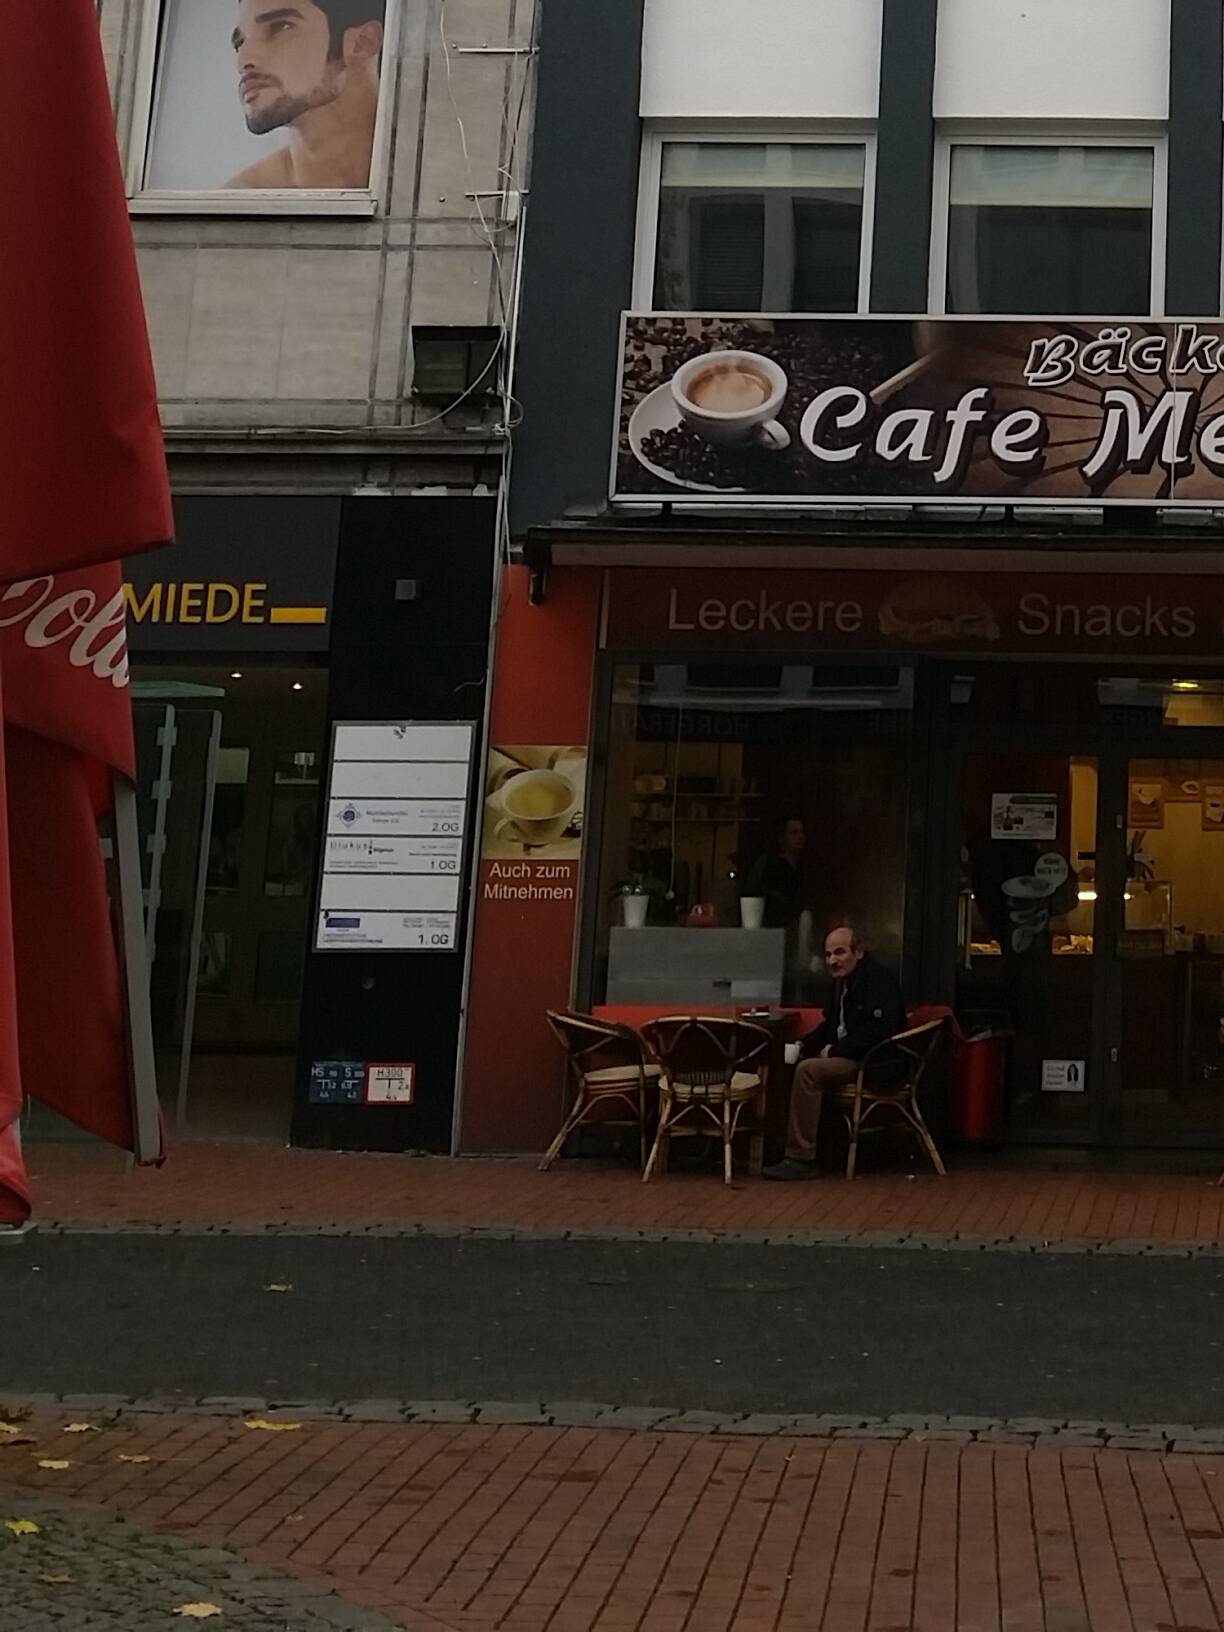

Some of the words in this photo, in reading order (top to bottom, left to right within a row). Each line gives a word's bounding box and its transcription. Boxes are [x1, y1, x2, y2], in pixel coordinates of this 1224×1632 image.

[798, 386, 1048, 485] Cafe
[667, 588, 863, 634] Leckere
[1017, 592, 1196, 639] Snacks
[489, 860, 529, 880] Auch
[534, 865, 571, 880] zum
[484, 881, 574, 901] Mitnehmen
